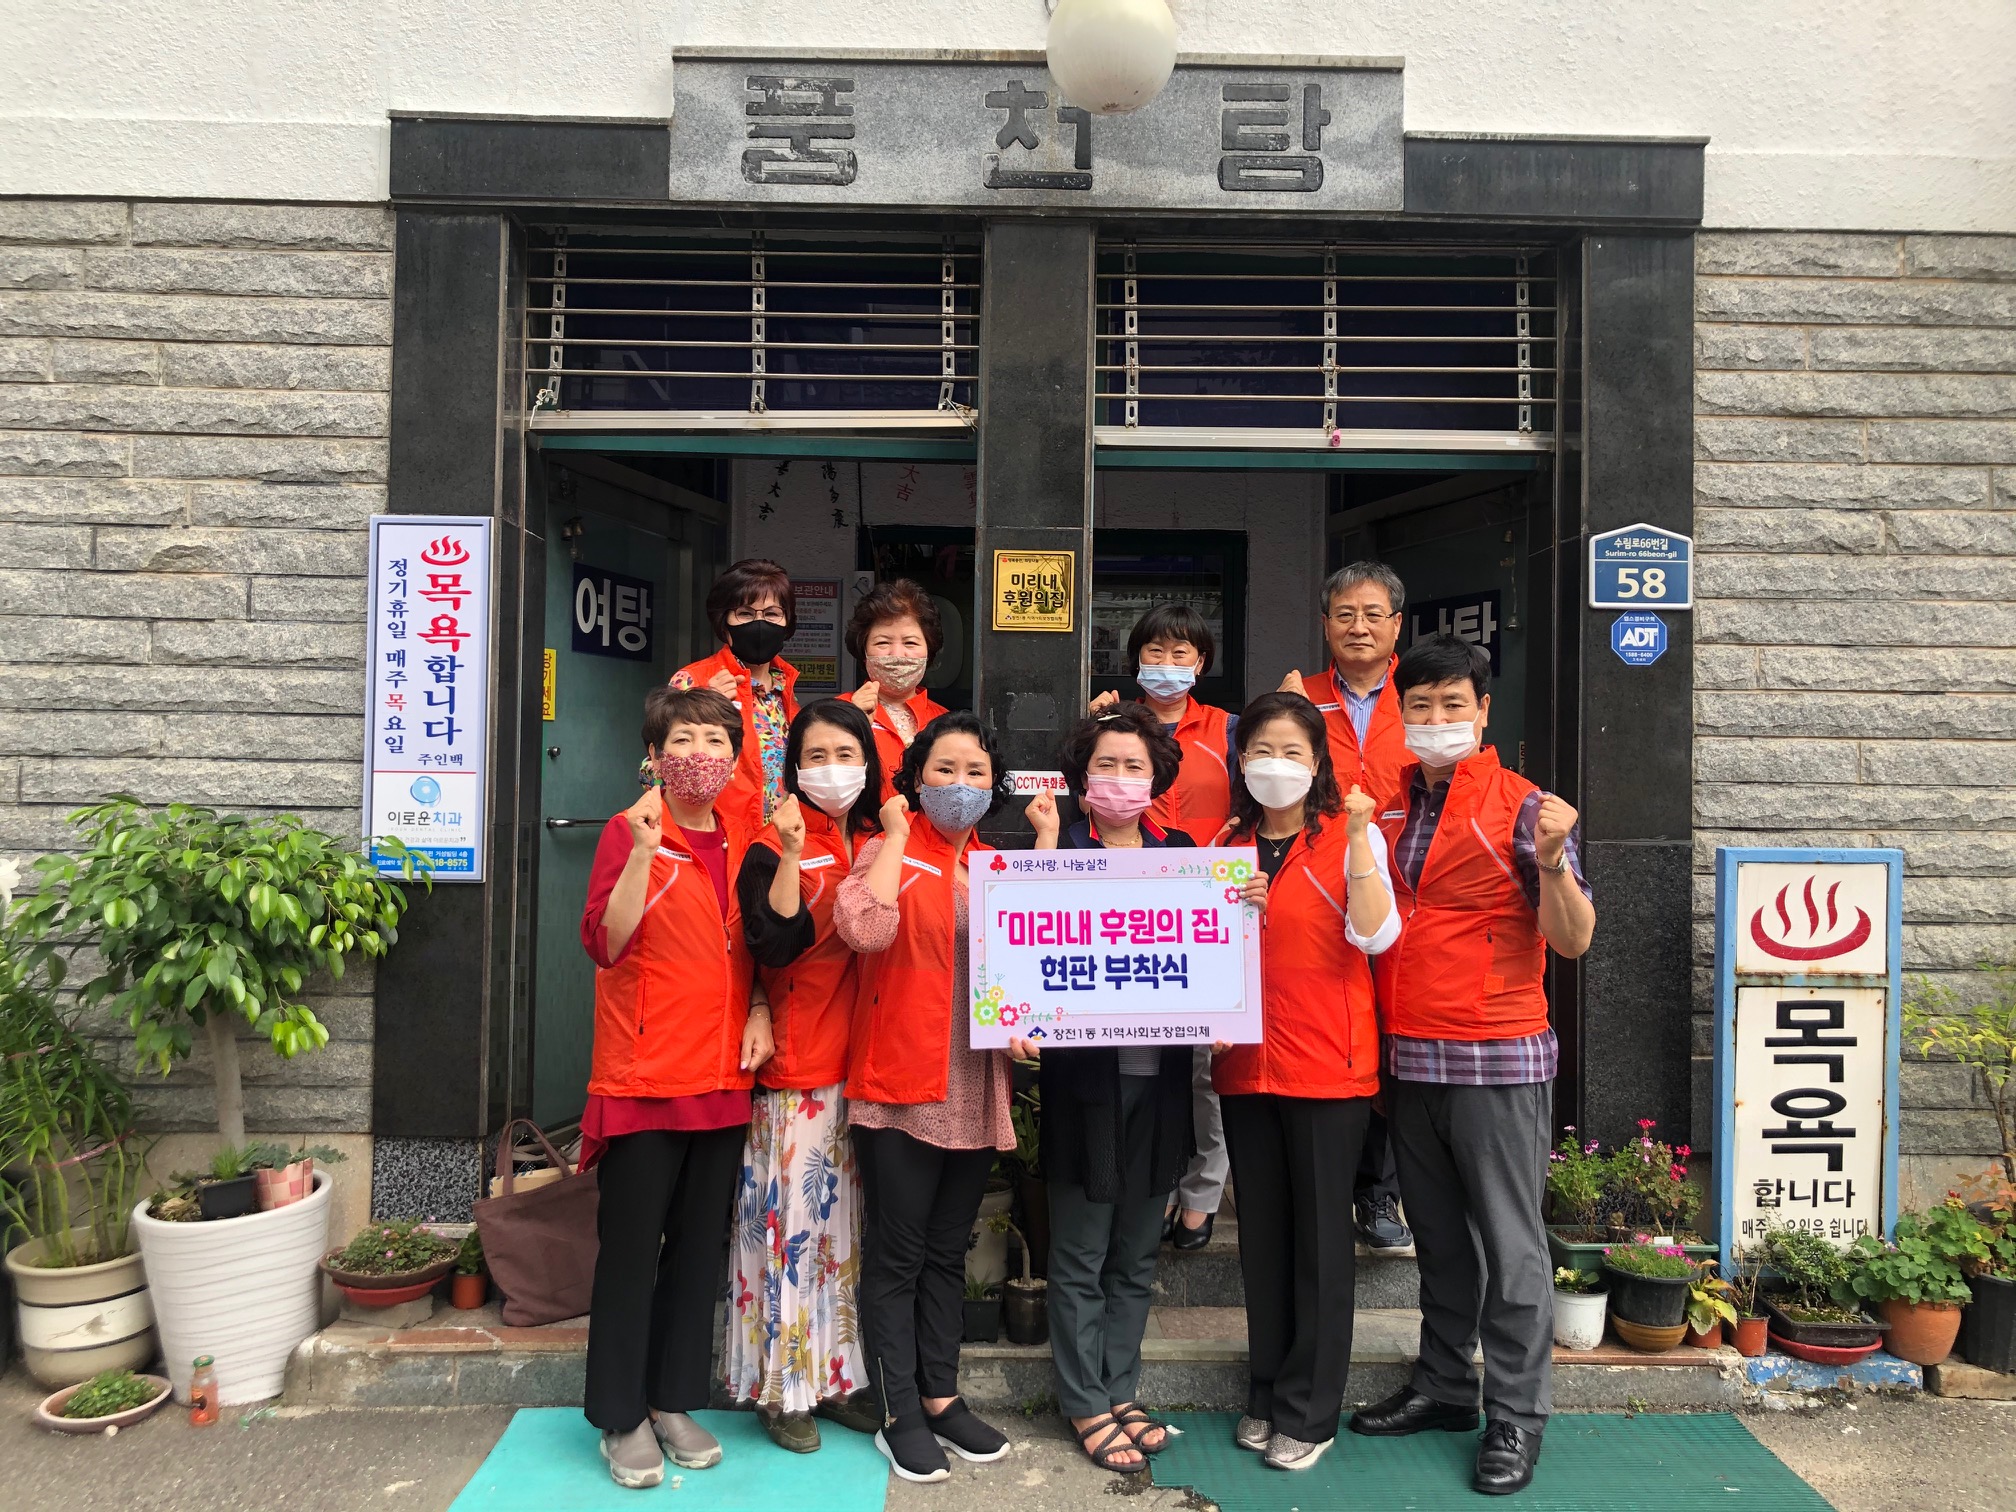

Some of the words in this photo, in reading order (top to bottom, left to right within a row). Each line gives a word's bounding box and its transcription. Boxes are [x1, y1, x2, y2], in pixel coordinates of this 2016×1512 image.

[1613, 537, 1669, 550] 수림로66번길
[1638, 550, 1677, 559] 66beon-gil
[1011, 573, 1057, 590] 미리내
[1617, 567, 1667, 599] 58
[386, 558, 409, 639] 정기휴일
[575, 577, 651, 652] 여탕
[1620, 627, 1658, 647] ADT
[417, 573, 472, 746] 목욕합니다
[418, 753, 463, 766] 주인백
[388, 811, 462, 826] 이로운치과
[1012, 859, 1059, 872] 이웃사랑,
[1063, 858, 1107, 872] 나눔실천
[1100, 907, 1183, 945] 후원의
[1040, 954, 1097, 991] 현판
[1104, 952, 1189, 990] 부착식
[1053, 1028, 1097, 1040] 장전1동
[1101, 1026, 1210, 1039] 지역사회보장협의체
[1761, 1000, 1857, 1172] 목욕
[1753, 1178, 1856, 1208] 합니다
[1742, 1218, 1767, 1239] 매주
